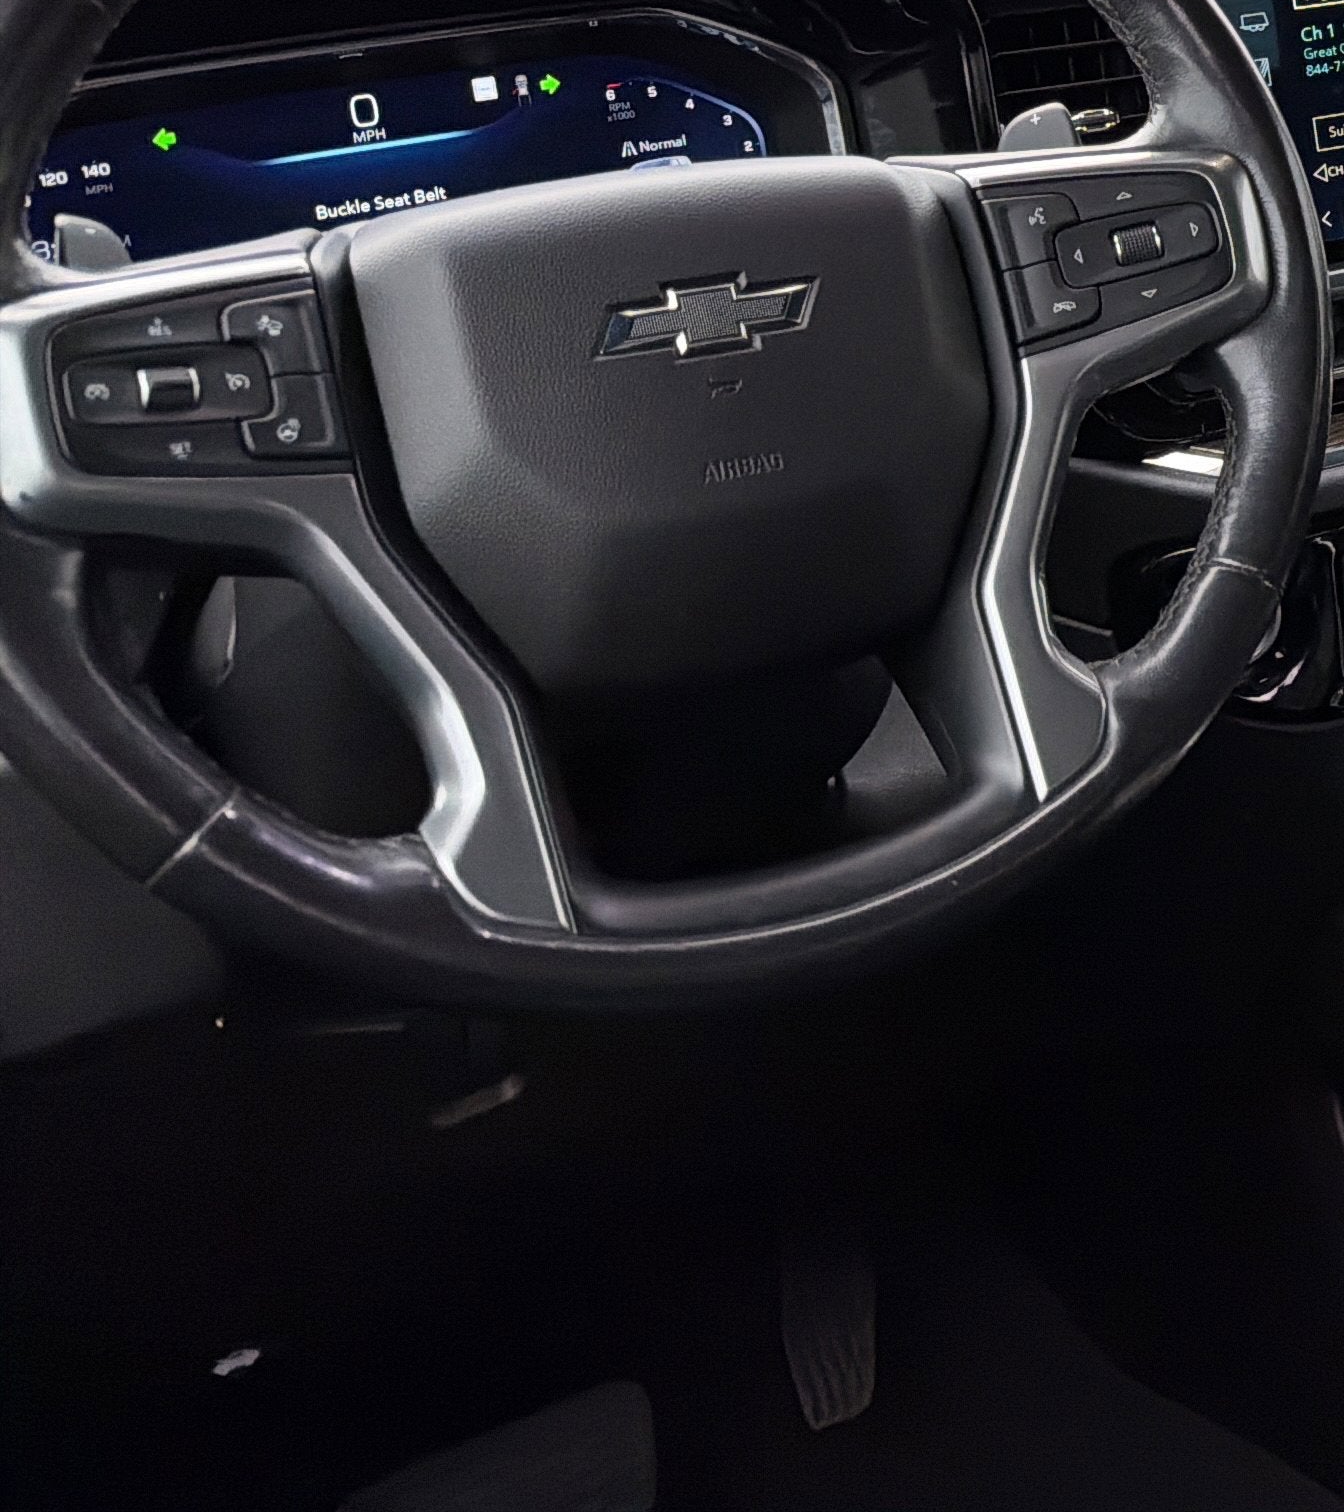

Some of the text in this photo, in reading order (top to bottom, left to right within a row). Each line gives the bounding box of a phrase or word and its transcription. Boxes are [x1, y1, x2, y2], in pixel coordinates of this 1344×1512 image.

[1301, 24, 1323, 42] Ch
[1327, 25, 1335, 39] 1
[1304, 46, 1337, 61] Great
[606, 88, 616, 101] 6
[646, 86, 657, 98] 5
[350, 93, 380, 128] 0
[608, 101, 631, 113] RPM
[685, 98, 695, 110] 4
[607, 110, 636, 123] x1000
[722, 114, 733, 126] 3
[353, 128, 386, 144] MPH
[639, 134, 687, 153] Normal
[743, 140, 754, 152] 2
[81, 162, 111, 179] 140
[1328, 165, 1344, 178] CH
[39, 170, 68, 187] 120
[85, 182, 113, 195] MPH
[315, 186, 448, 221] Buckle Seat Belt
[704, 454, 784, 486] AIRBAG
